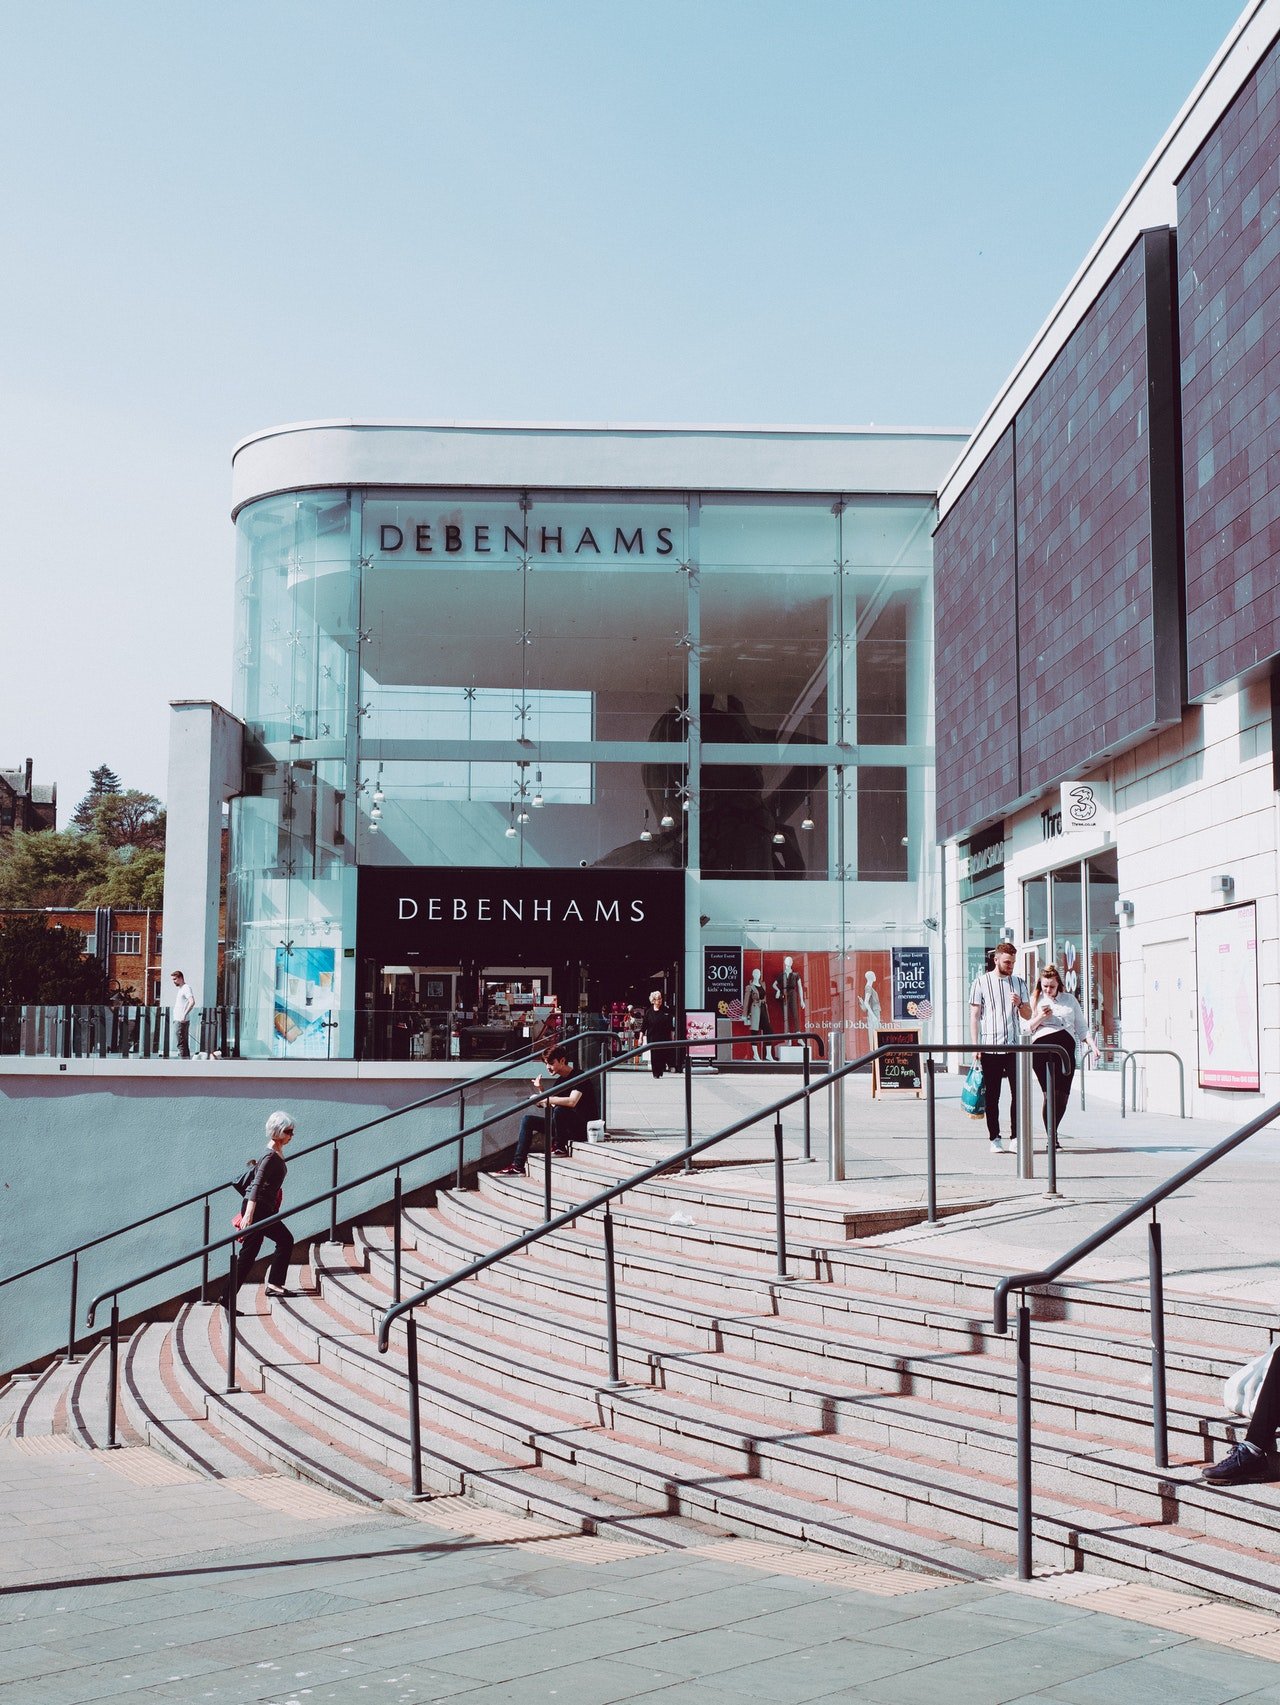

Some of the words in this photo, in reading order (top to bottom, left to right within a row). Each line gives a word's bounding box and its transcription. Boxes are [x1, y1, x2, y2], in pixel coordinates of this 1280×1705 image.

[380, 525, 673, 554] DEBENHAMS
[1070, 786, 1096, 820] 3
[398, 898, 645, 922] DEBENHAMS
[708, 965, 738, 980] 30%
[897, 966, 924, 981] half
[898, 981, 925, 992] price
[845, 1020, 900, 1029] Debehams
[885, 1066, 900, 1076] £20
